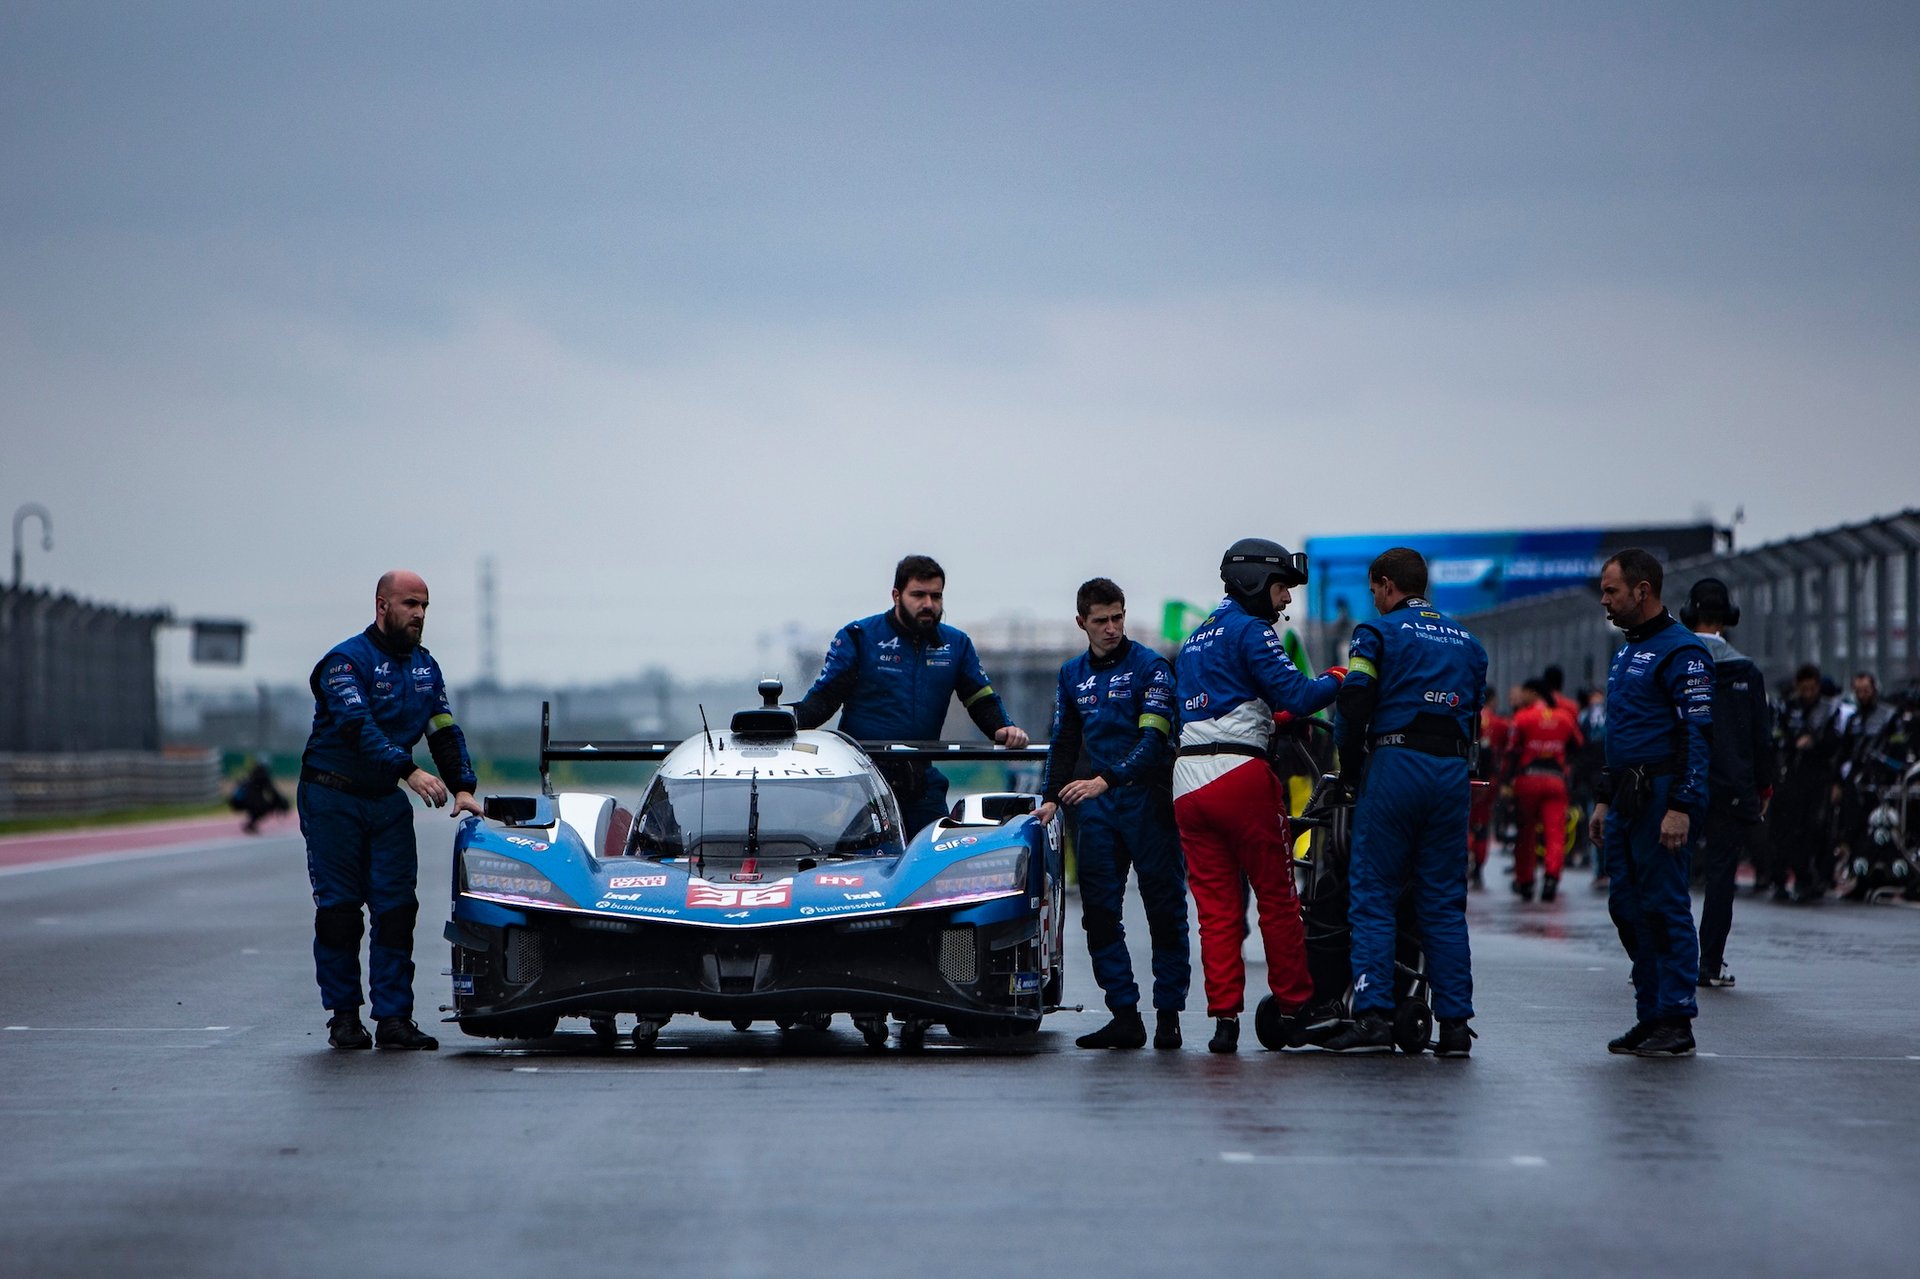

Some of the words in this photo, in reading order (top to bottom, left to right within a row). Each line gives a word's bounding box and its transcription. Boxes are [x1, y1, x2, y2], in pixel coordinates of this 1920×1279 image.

[1401, 622, 1470, 639] ALPINE
[1415, 632, 1449, 643] ENDURANCE
[1077, 695, 1089, 705] elf
[1185, 696, 1201, 711] elf
[1424, 691, 1447, 704] elf
[683, 768, 836, 776] ALPINE
[506, 836, 534, 848] elf
[934, 839, 960, 852] elf
[820, 876, 859, 886] HY
[690, 886, 788, 906] 36
[610, 903, 680, 916] businessolver
[816, 901, 887, 913] businessolver
